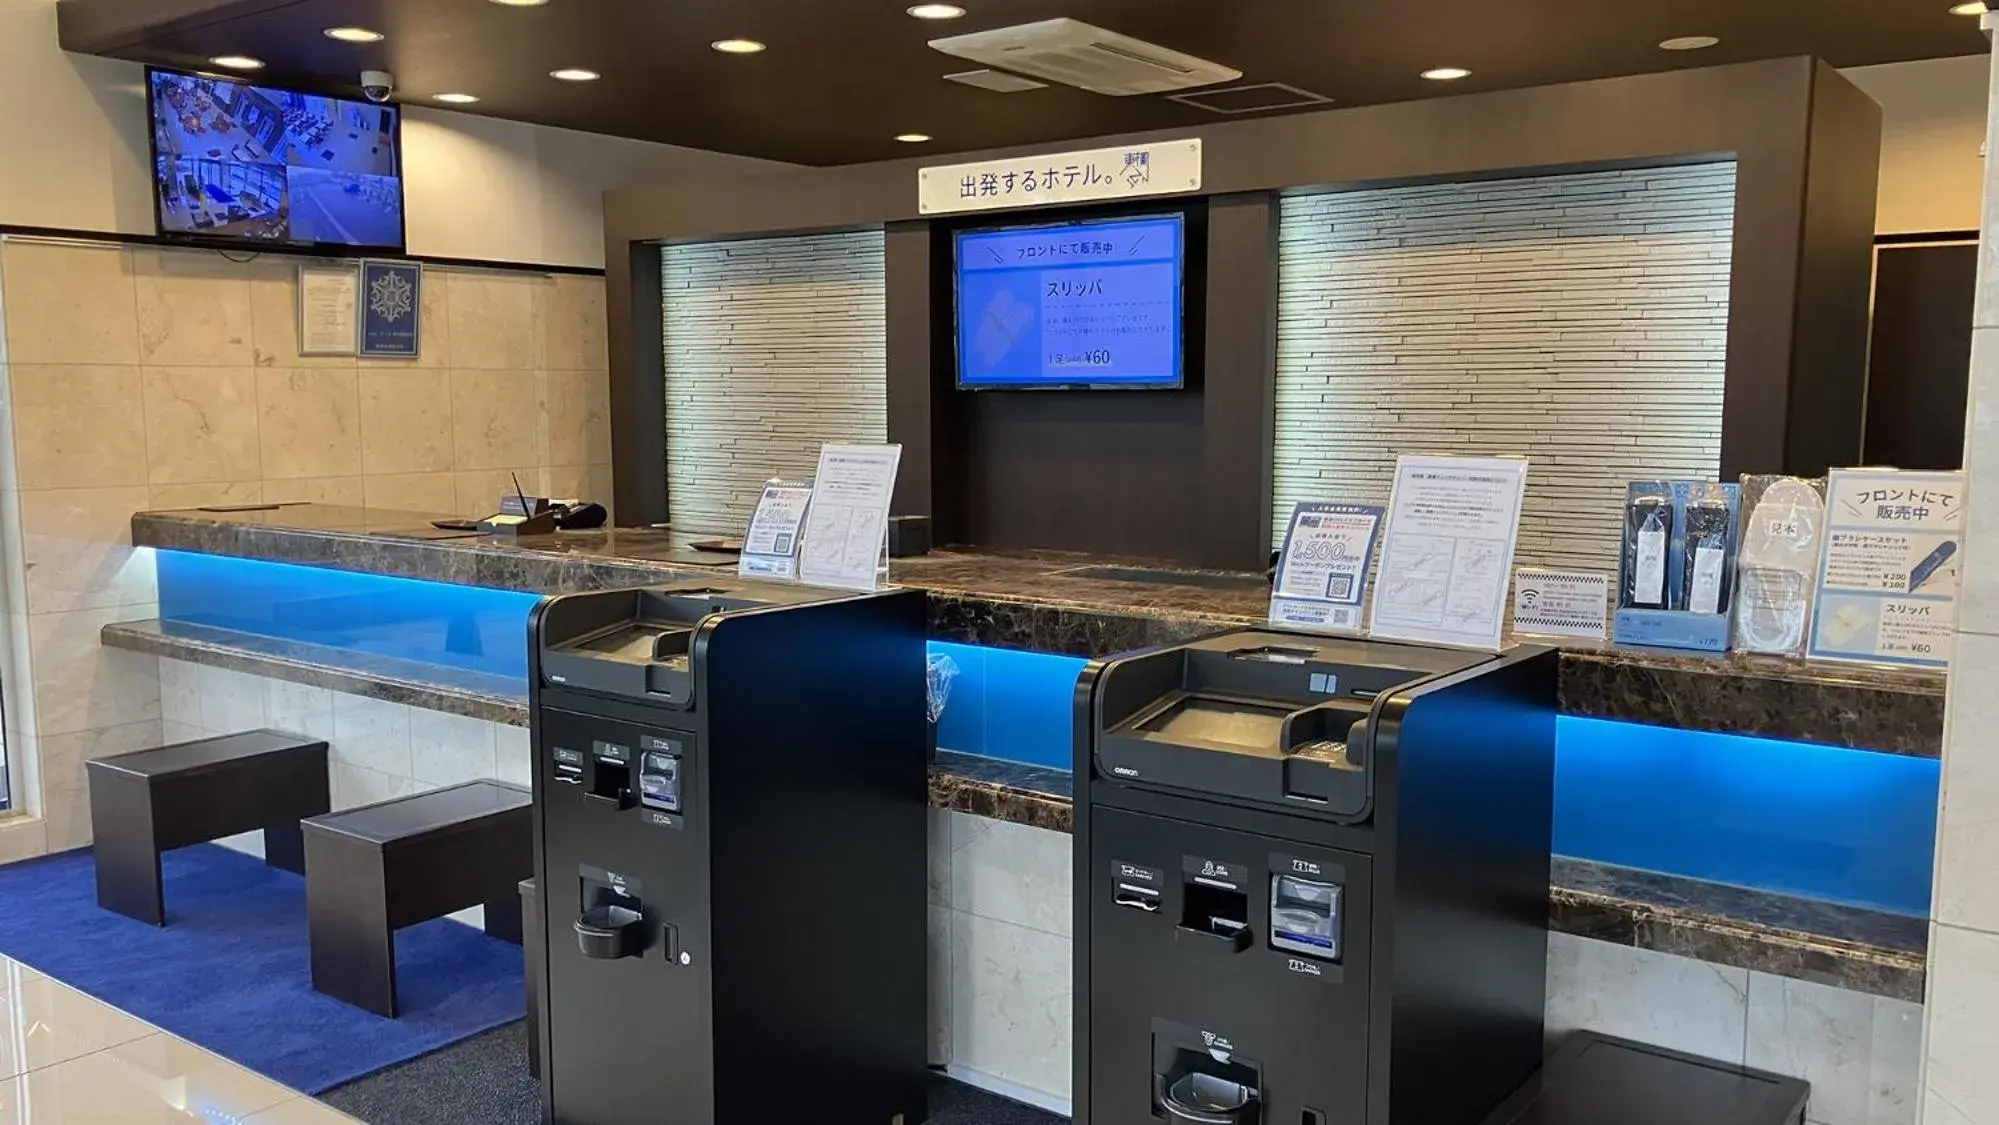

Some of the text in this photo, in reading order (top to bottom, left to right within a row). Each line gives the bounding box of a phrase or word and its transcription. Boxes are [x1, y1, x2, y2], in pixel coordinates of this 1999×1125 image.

[960, 167, 1113, 198] 出発するホテル。
[1017, 242, 1113, 259] フロントにて販売中
[1047, 278, 1102, 297] スリッパ
[1086, 350, 1110, 364] ¥60
[1856, 489, 1954, 507] フロントにて
[1876, 505, 1930, 521] 販売中
[1771, 521, 1796, 536] 見本
[1886, 604, 1931, 616] スリッパ
[1911, 643, 1931, 653] ¥60
